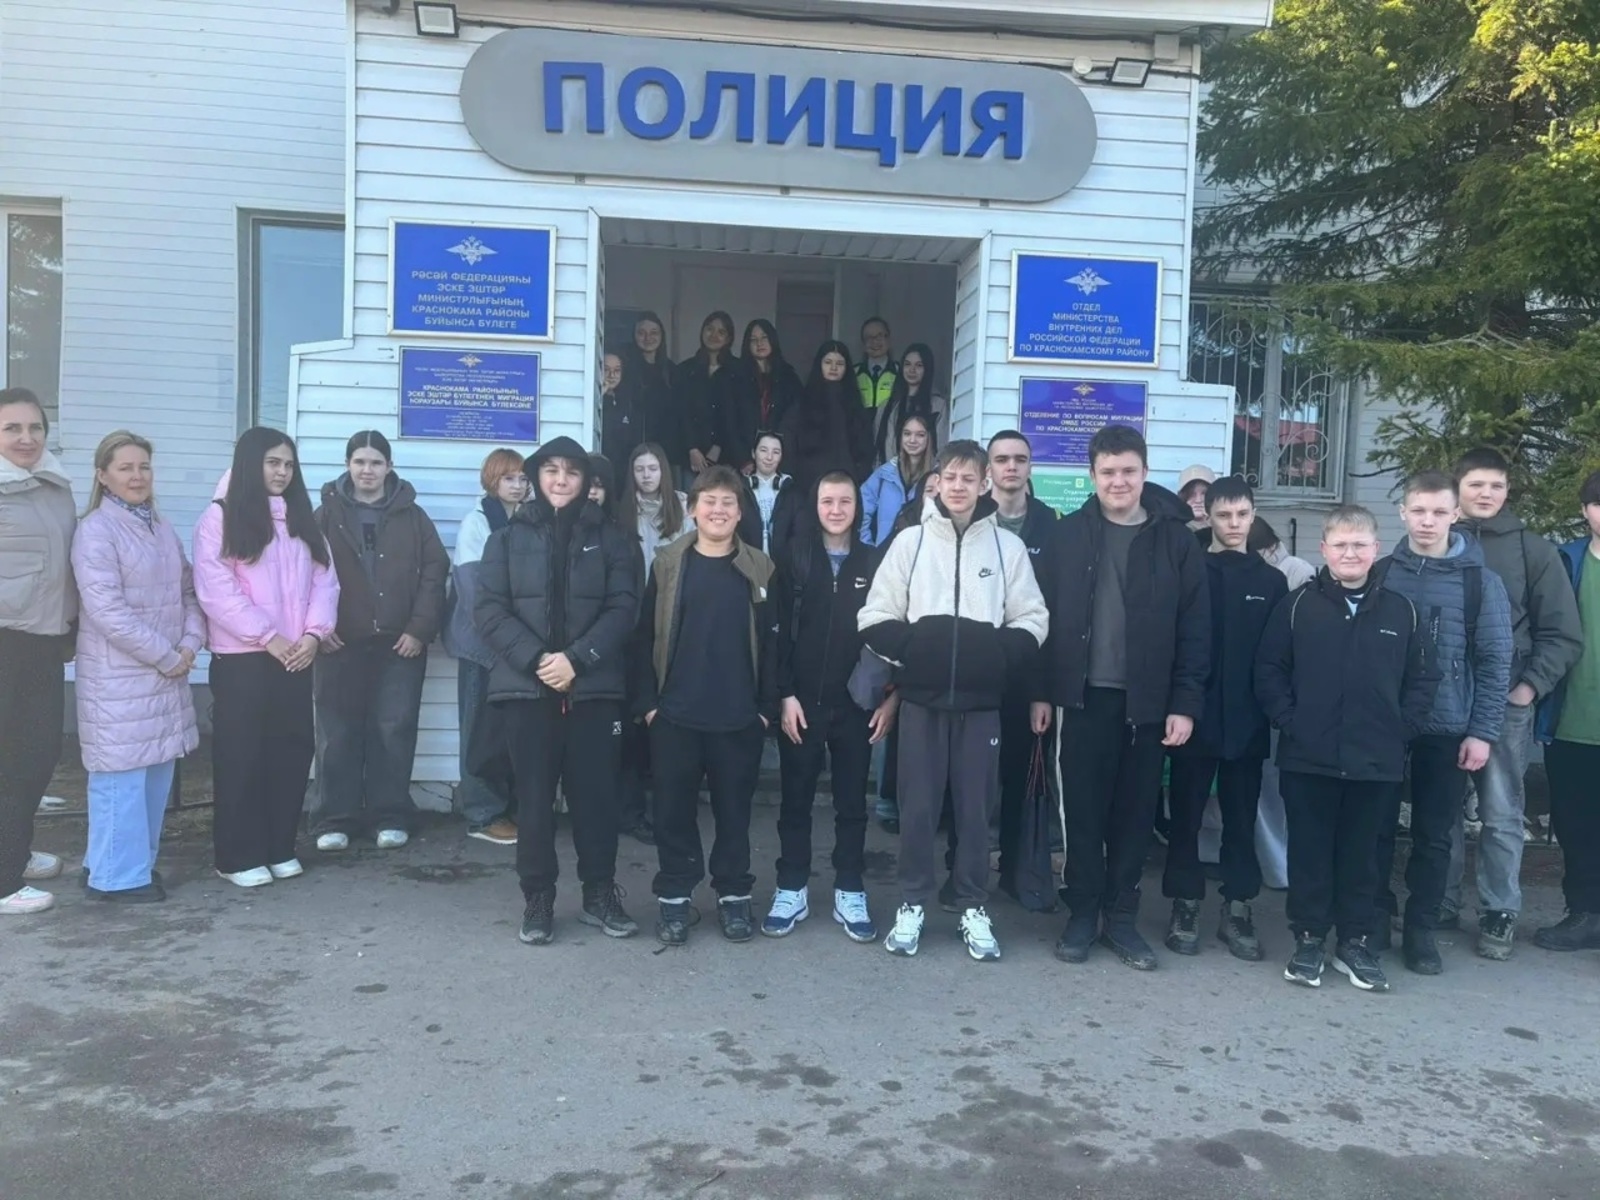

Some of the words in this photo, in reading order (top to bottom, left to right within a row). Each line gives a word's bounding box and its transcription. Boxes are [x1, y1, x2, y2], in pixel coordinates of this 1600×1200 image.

[543, 61, 1025, 168] ПОЛИЦИЯ
[411, 270, 448, 280] РӘСӘЙ
[437, 283, 465, 293] ЭСКЕ
[468, 284, 506, 294] ЭШТӘР
[411, 305, 482, 316] КРАСНОКАМА
[485, 307, 530, 319] РАЙОНЫ
[1072, 302, 1101, 312] ОТДЕЛ
[424, 316, 475, 328] БУЙЫНСА
[1052, 312, 1120, 324] МИНИСТЕРСТВА
[1048, 323, 1102, 333] ВНУТРЕННИХ
[1105, 325, 1122, 335] ДЕЛ
[1029, 332, 1087, 343] РОССИЙСКОЙ
[1089, 335, 1141, 346] ФЕДЕРАЦИИ
[1019, 343, 1032, 352] ПО
[1034, 344, 1114, 356] КРАСНОКАМСКОМУ
[1116, 346, 1150, 357] РАЙОНУ
[1023, 411, 1060, 419] ОТДЕЛЕНИЕ
[1074, 413, 1108, 421] ВОПРОСАМ
